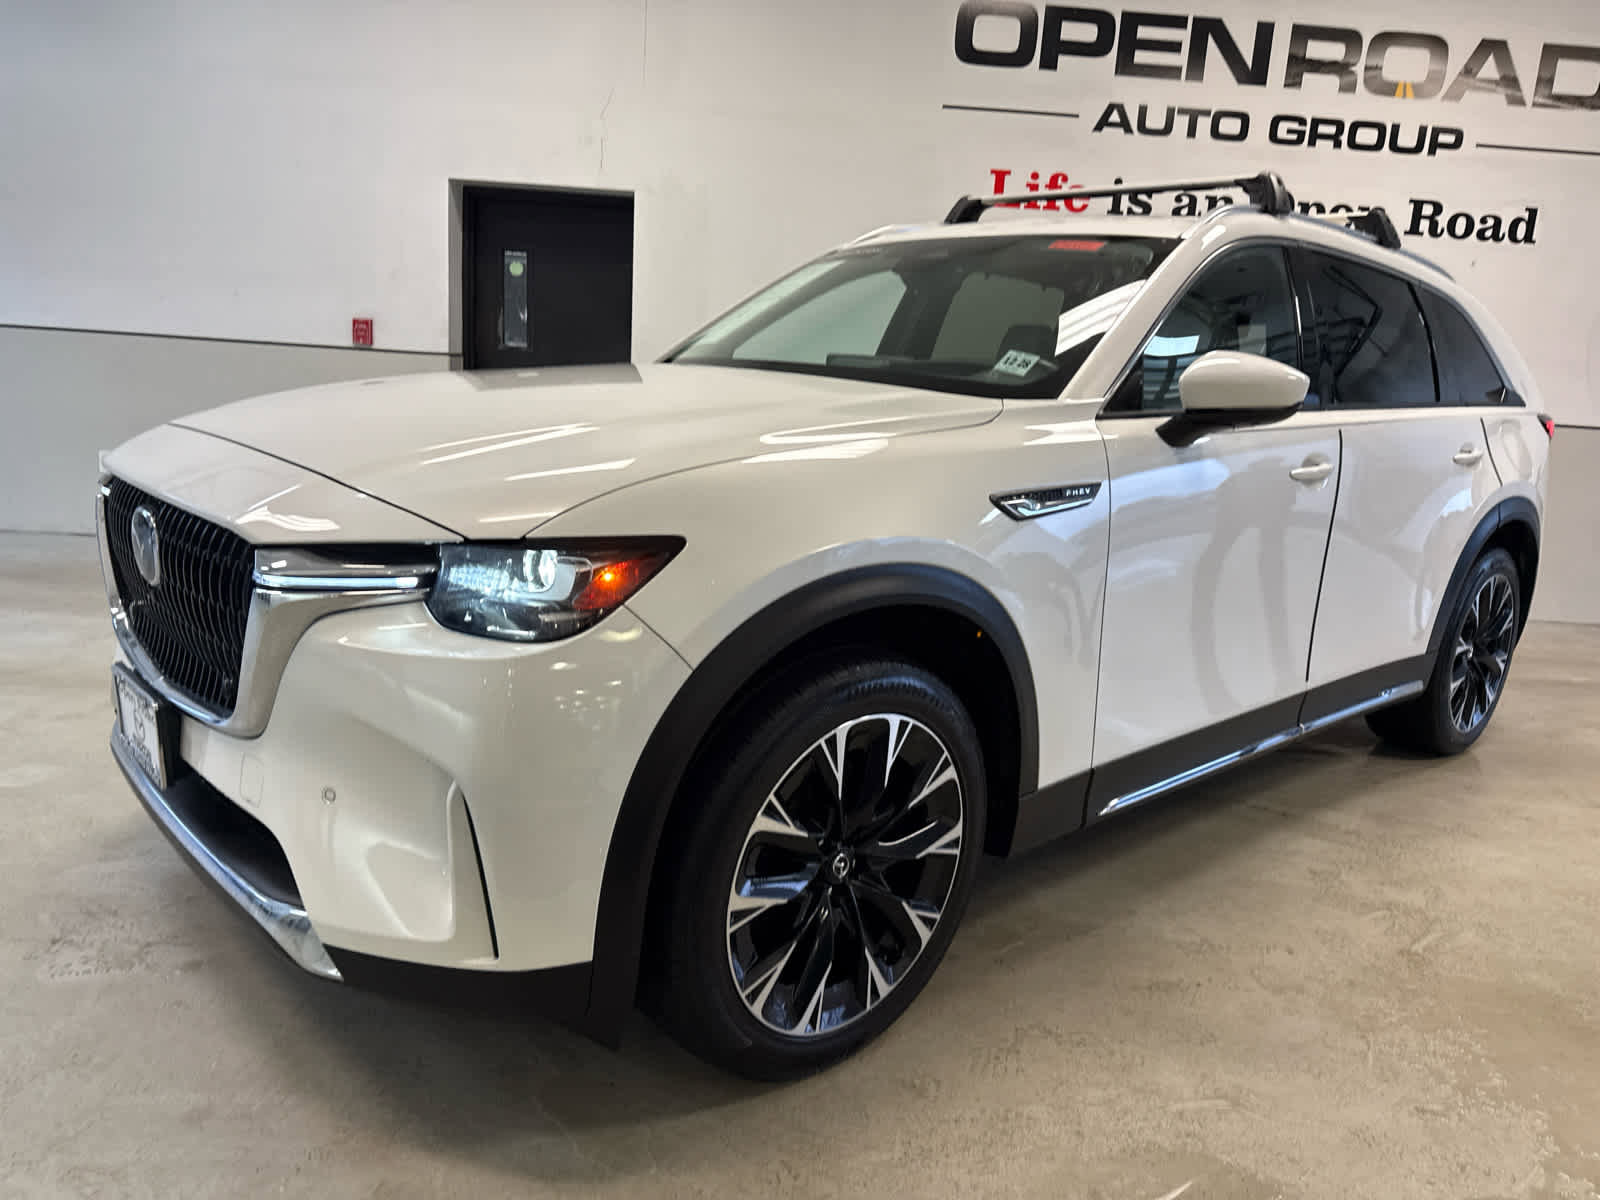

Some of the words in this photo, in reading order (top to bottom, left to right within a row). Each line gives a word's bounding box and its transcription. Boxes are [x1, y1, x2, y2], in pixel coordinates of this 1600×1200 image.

[1092, 102, 1251, 142] AUTO
[1268, 114, 1464, 157] GROUP
[1106, 177, 1153, 217] is
[1404, 197, 1539, 245] Road
[1065, 487, 1092, 497] PHEV
